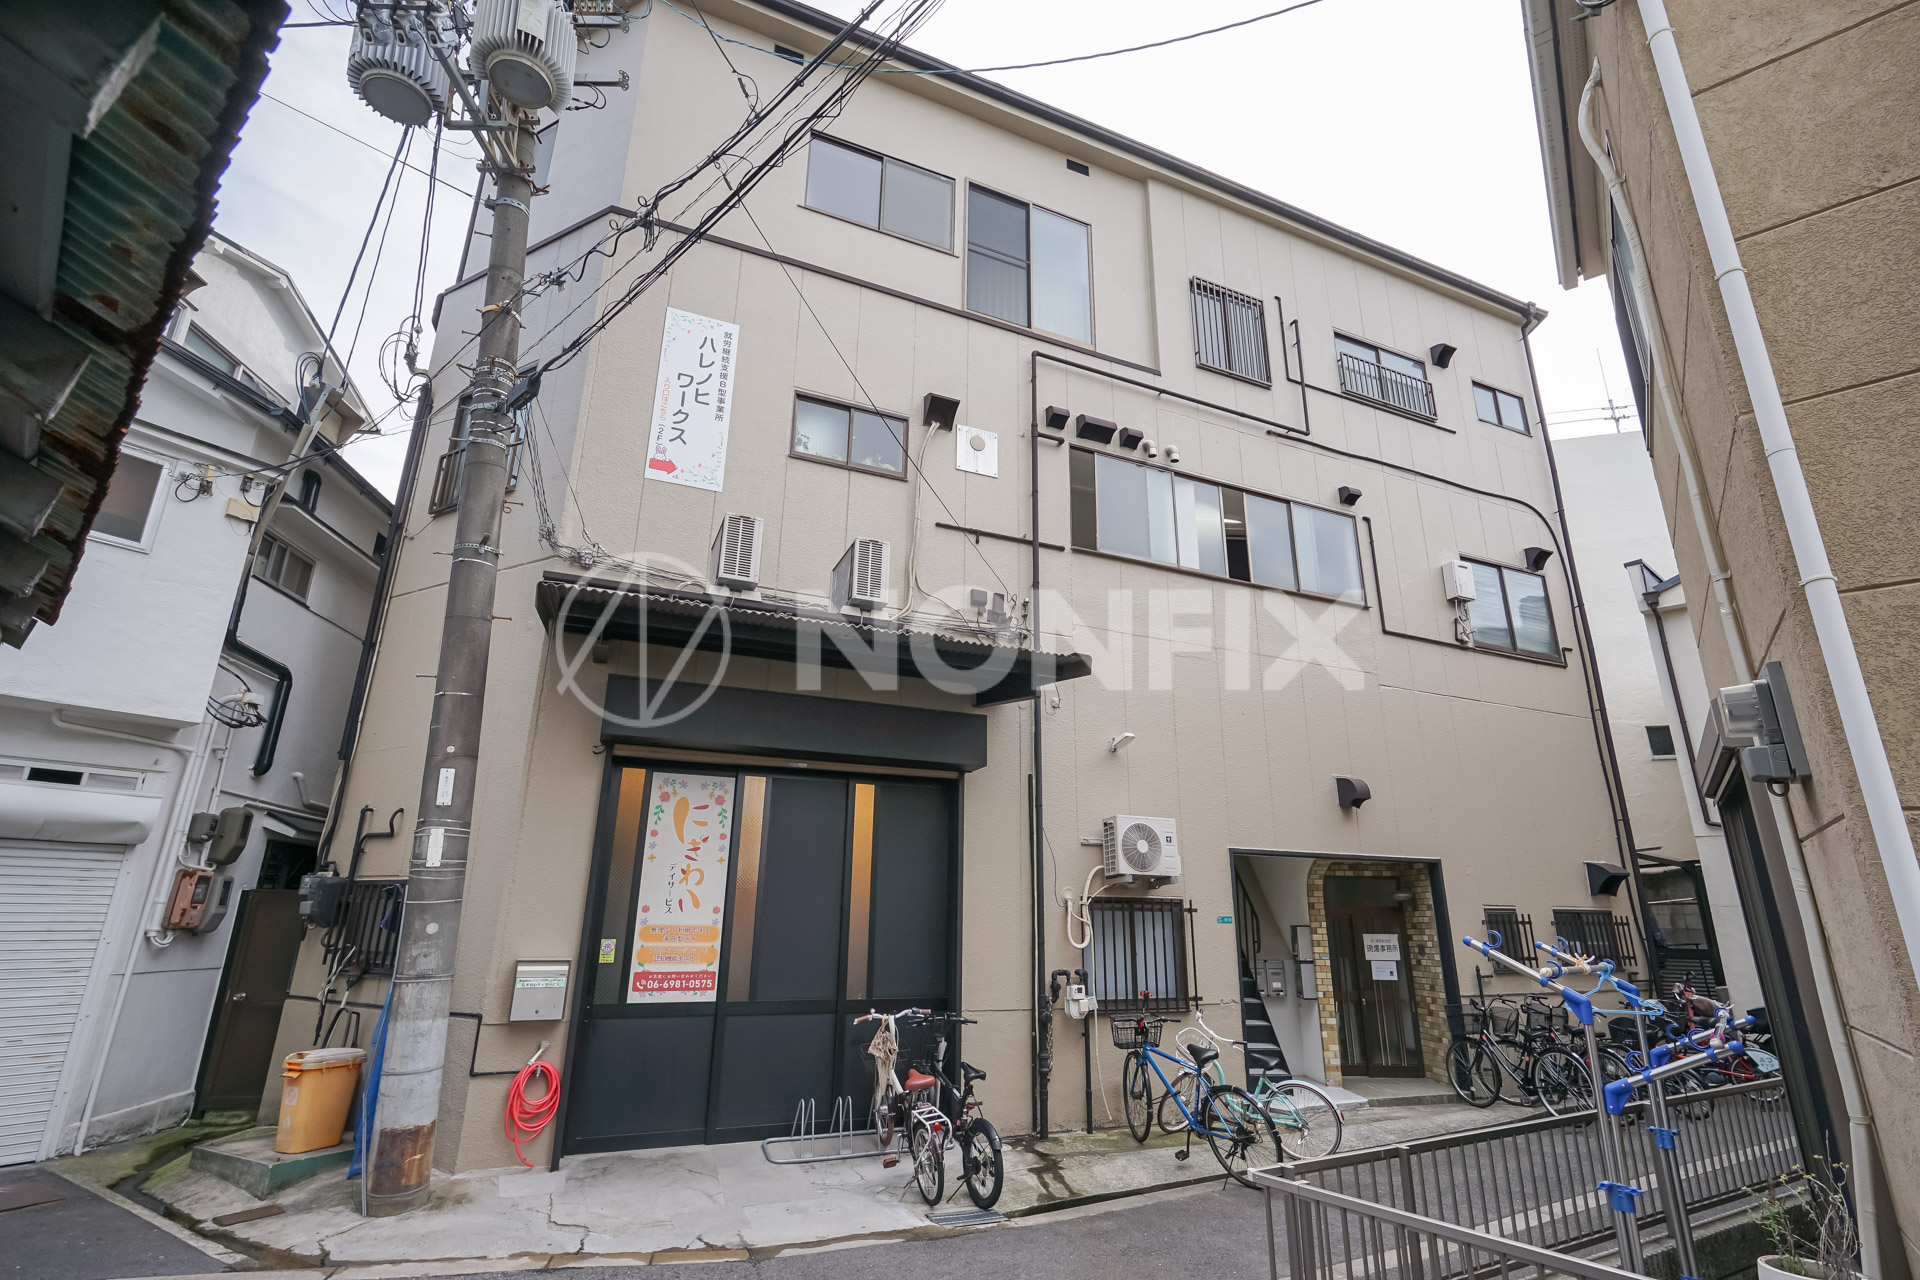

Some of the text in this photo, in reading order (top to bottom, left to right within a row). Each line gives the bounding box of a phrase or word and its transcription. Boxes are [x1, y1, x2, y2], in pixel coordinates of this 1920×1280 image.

[694, 336, 717, 406] ハレノヒ
[714, 331, 733, 422] 就労継続支援B型事業所
[668, 372, 694, 446] ワークス
[664, 863, 678, 914] デイサービス
[672, 796, 710, 913] にぎわい
[646, 979, 713, 989] 06-6981-0575
